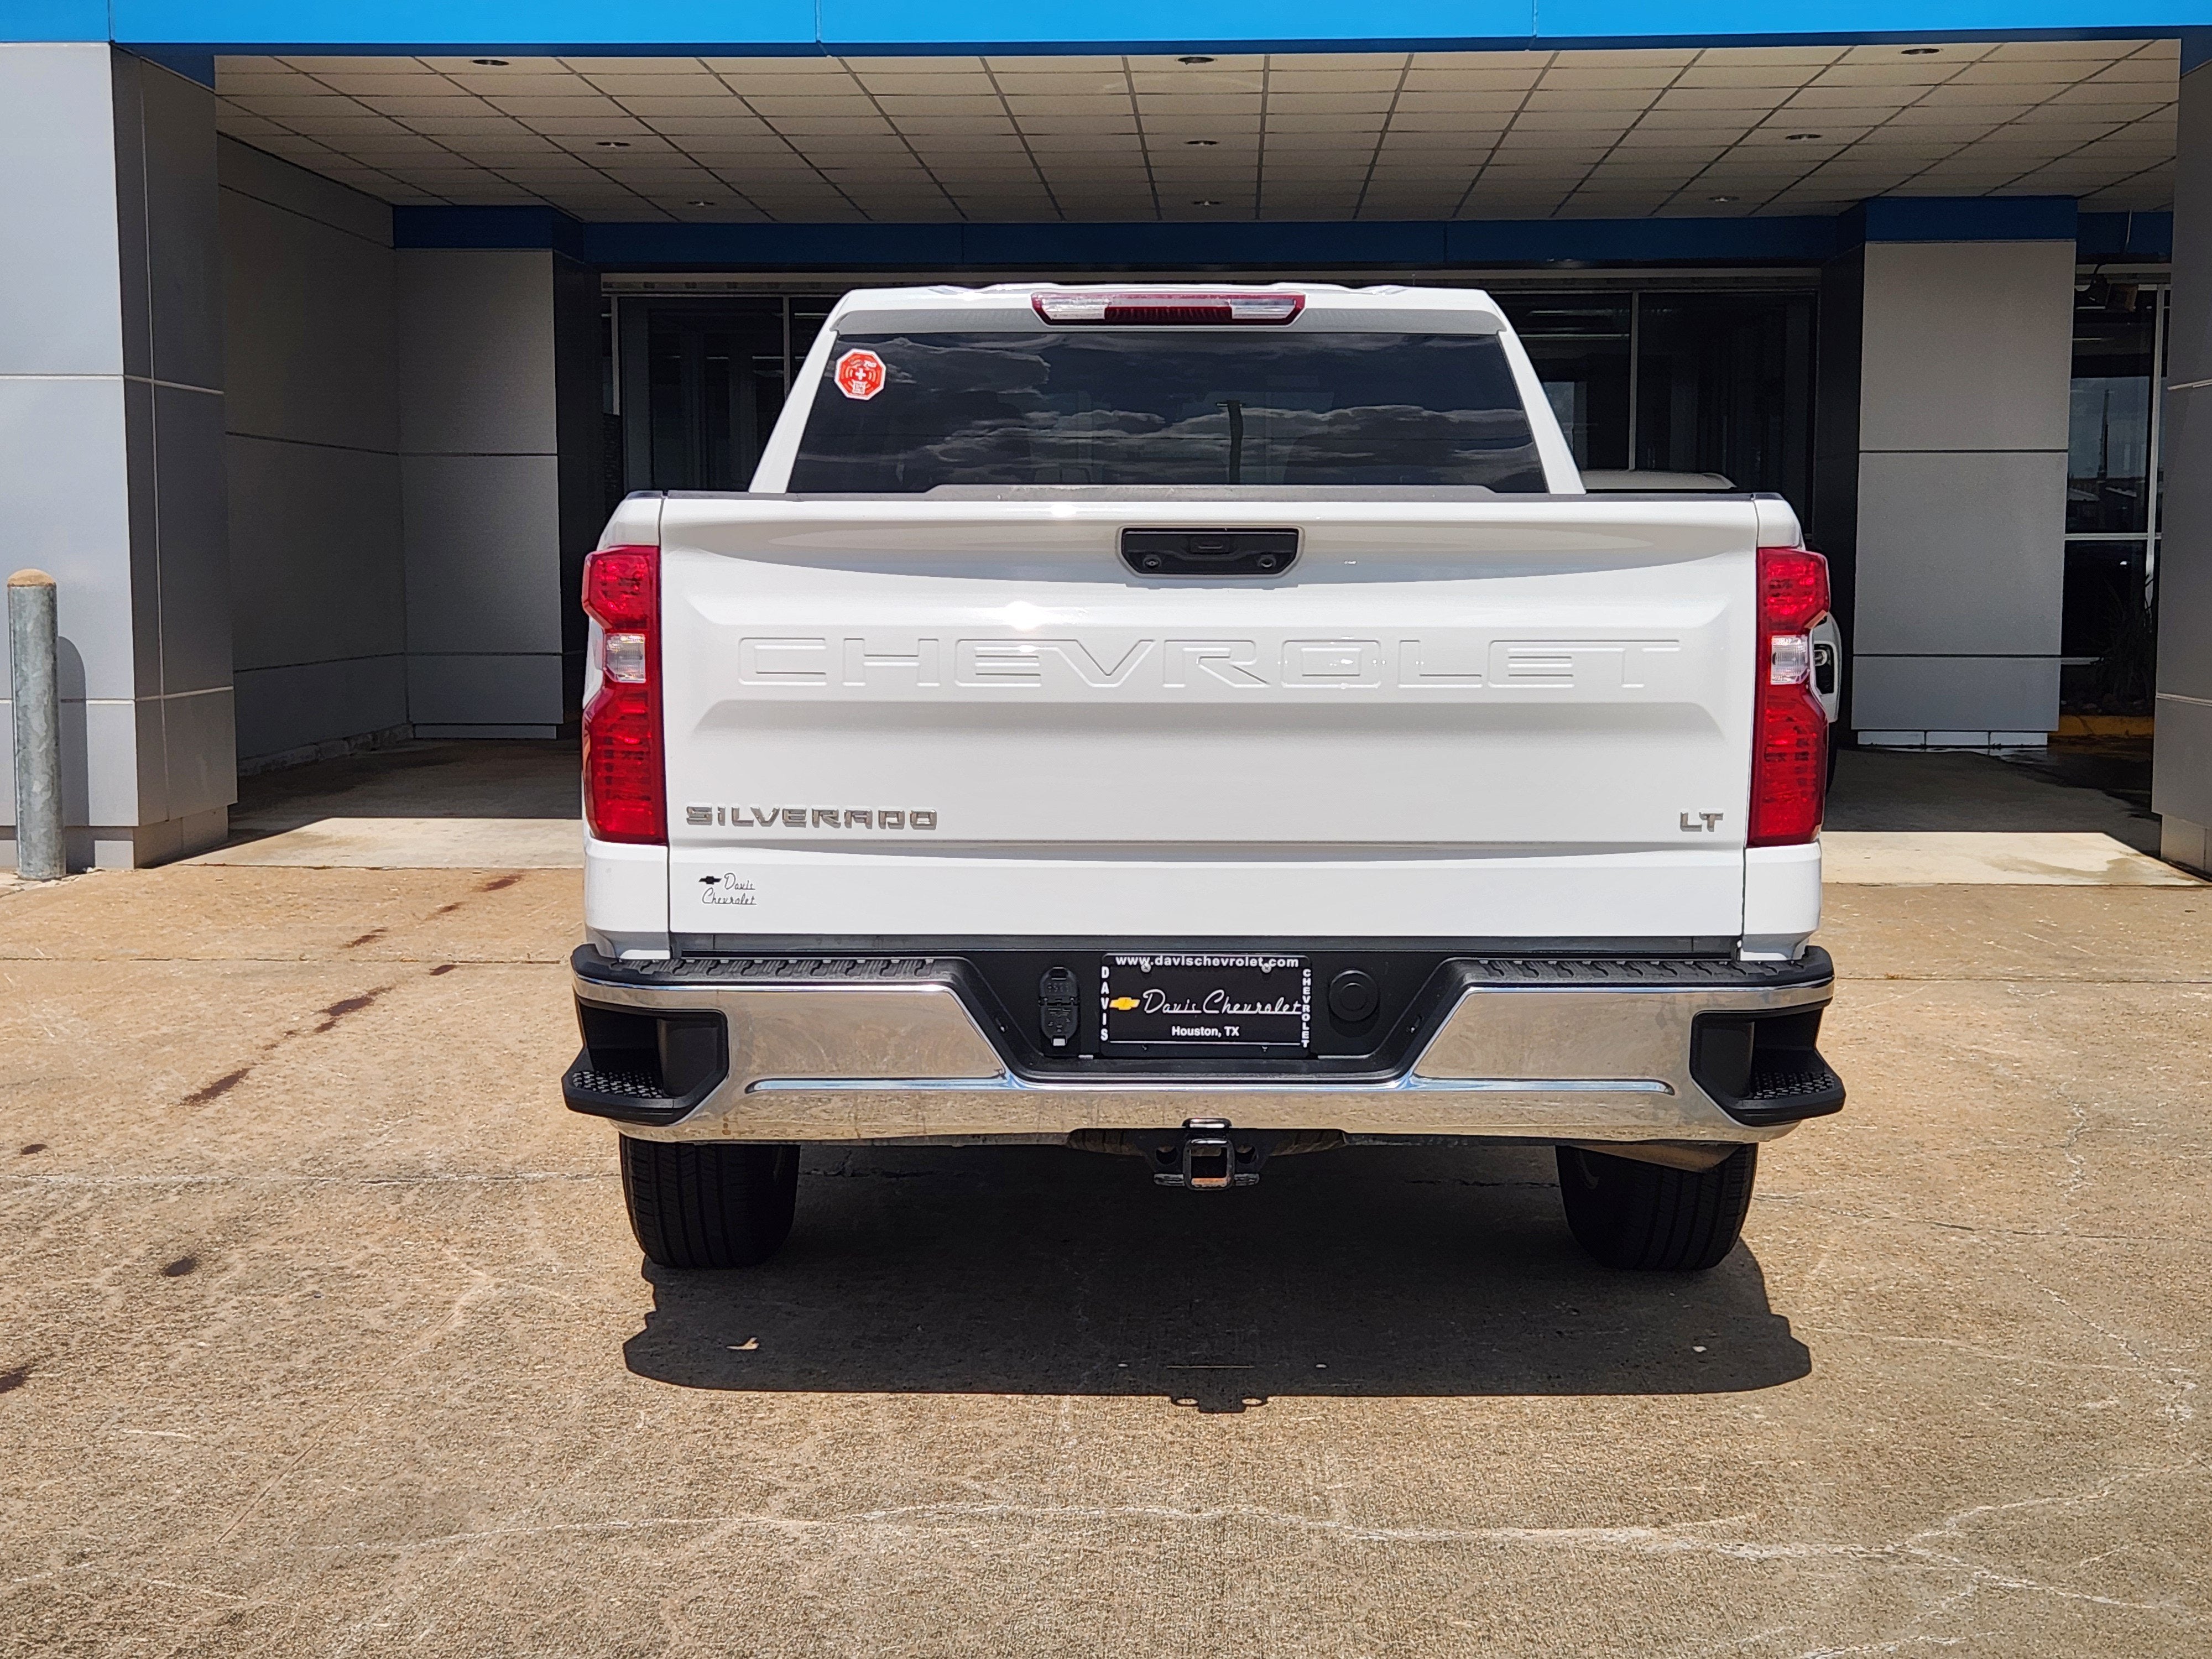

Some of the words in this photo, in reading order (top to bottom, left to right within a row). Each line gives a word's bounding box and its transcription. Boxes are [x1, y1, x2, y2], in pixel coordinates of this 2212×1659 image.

[738, 637, 1682, 687] CHEVROLET
[686, 805, 937, 830] SILVERADO
[1679, 808, 1724, 832] LT
[724, 873, 755, 890] Davis
[702, 887, 757, 905] Chevrolet
[1115, 955, 1299, 968] www.davischevrolet.com
[1100, 966, 1110, 1041] DAVIS
[1142, 989, 1202, 1014] Davis
[1202, 989, 1302, 1015] Chevrolet
[1301, 968, 1311, 1048] CHEVROLET
[1171, 1026, 1222, 1038] Houston,
[1224, 1026, 1240, 1037] TX
